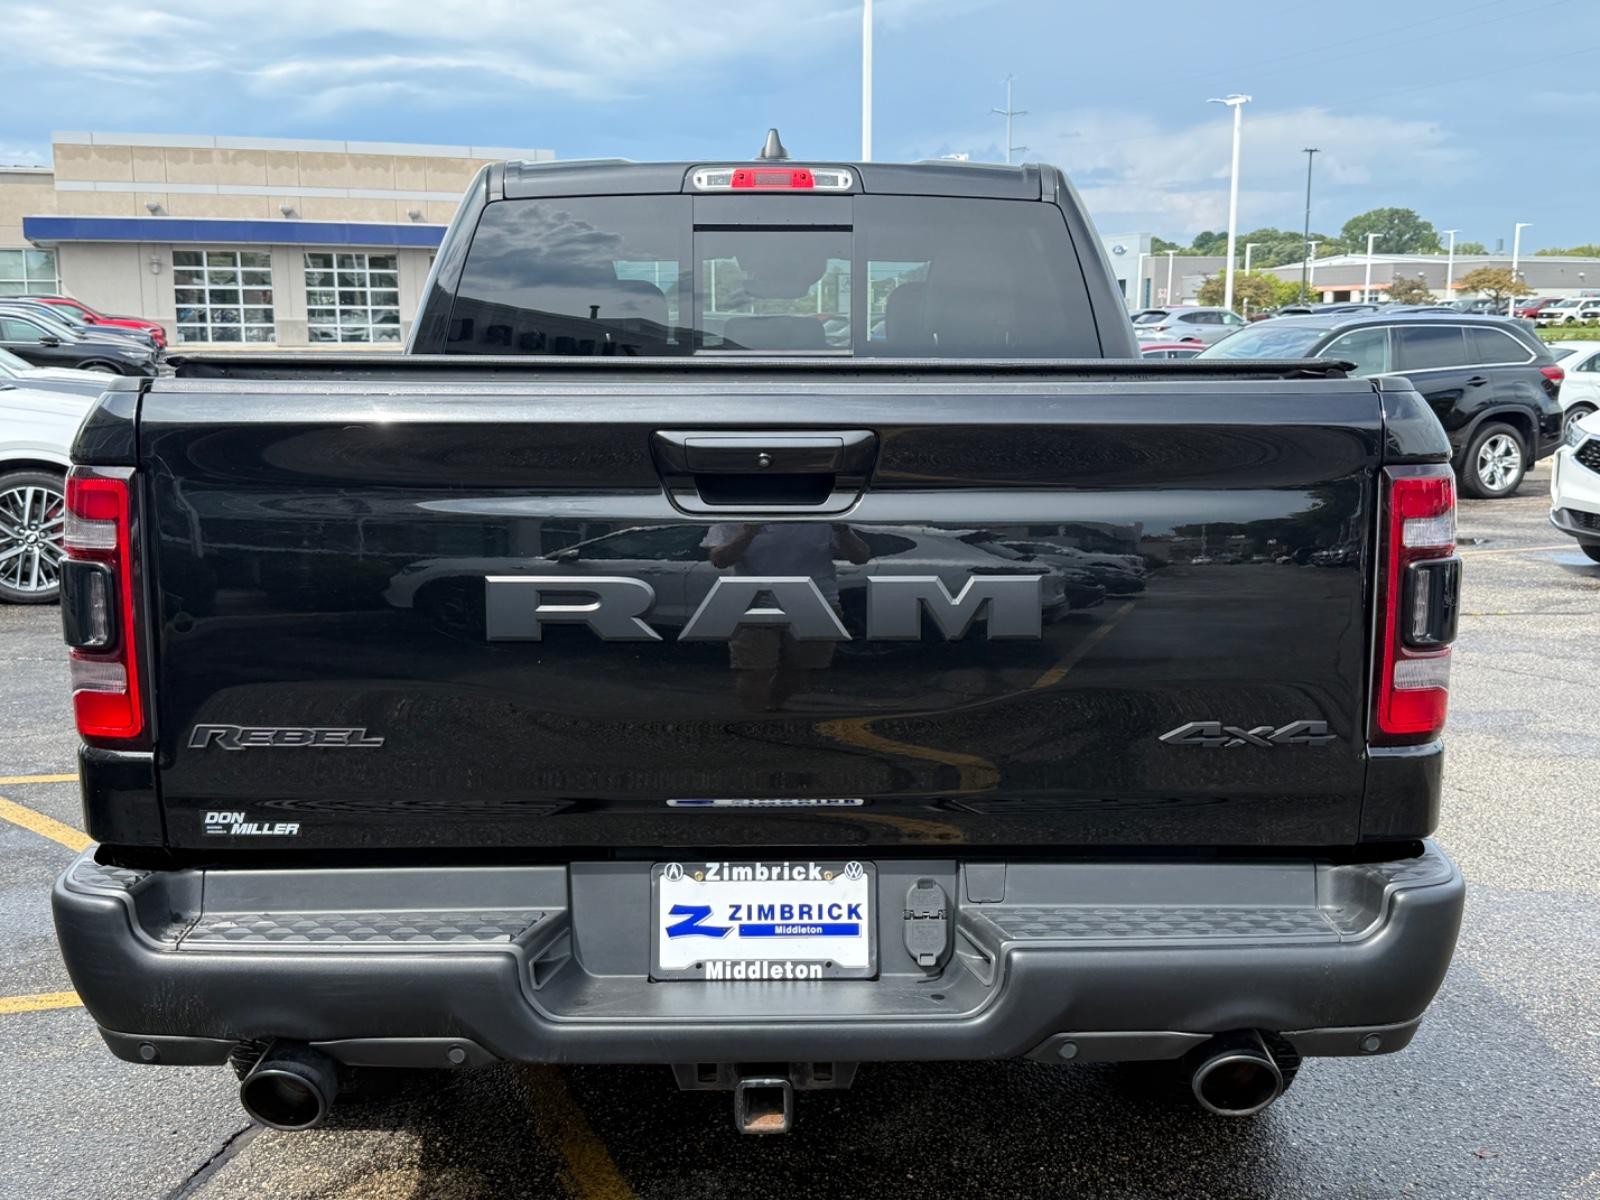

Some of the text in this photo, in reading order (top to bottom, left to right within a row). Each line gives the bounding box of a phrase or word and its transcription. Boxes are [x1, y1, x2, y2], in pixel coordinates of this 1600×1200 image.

[485, 575, 1042, 641] RAM
[187, 724, 385, 750] REBEL
[205, 811, 245, 824] DON
[230, 823, 300, 836] MILLER
[705, 862, 822, 881] Zimbrick
[728, 903, 863, 921] ZIMBRICK
[774, 925, 823, 935] Middleton
[705, 961, 823, 980] Middleton
